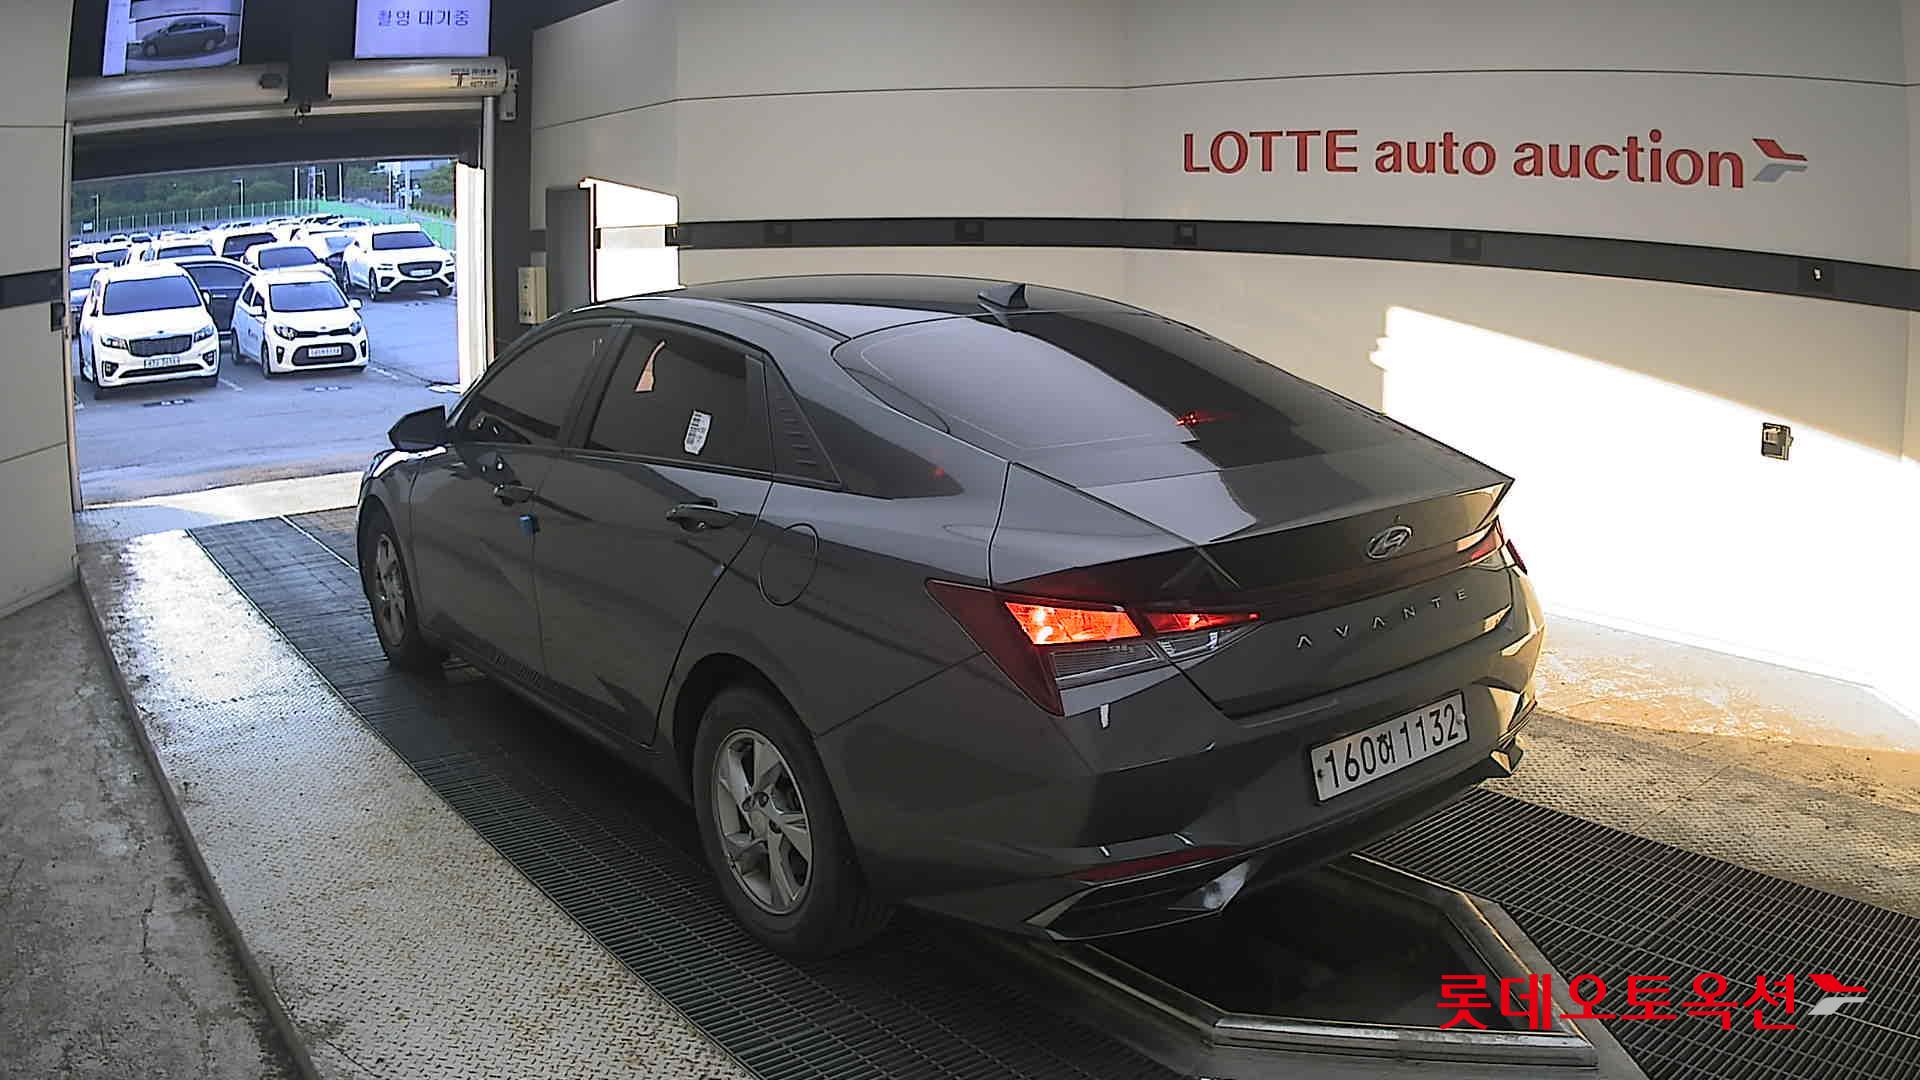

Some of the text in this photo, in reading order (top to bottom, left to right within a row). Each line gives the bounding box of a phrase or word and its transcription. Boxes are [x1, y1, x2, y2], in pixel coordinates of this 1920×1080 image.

[418, 9, 469, 26] 대기중
[1184, 129, 1744, 188] LOTTE auto auction
[1297, 588, 1468, 648] AVANTE
[1325, 704, 1459, 788] 160허1132
